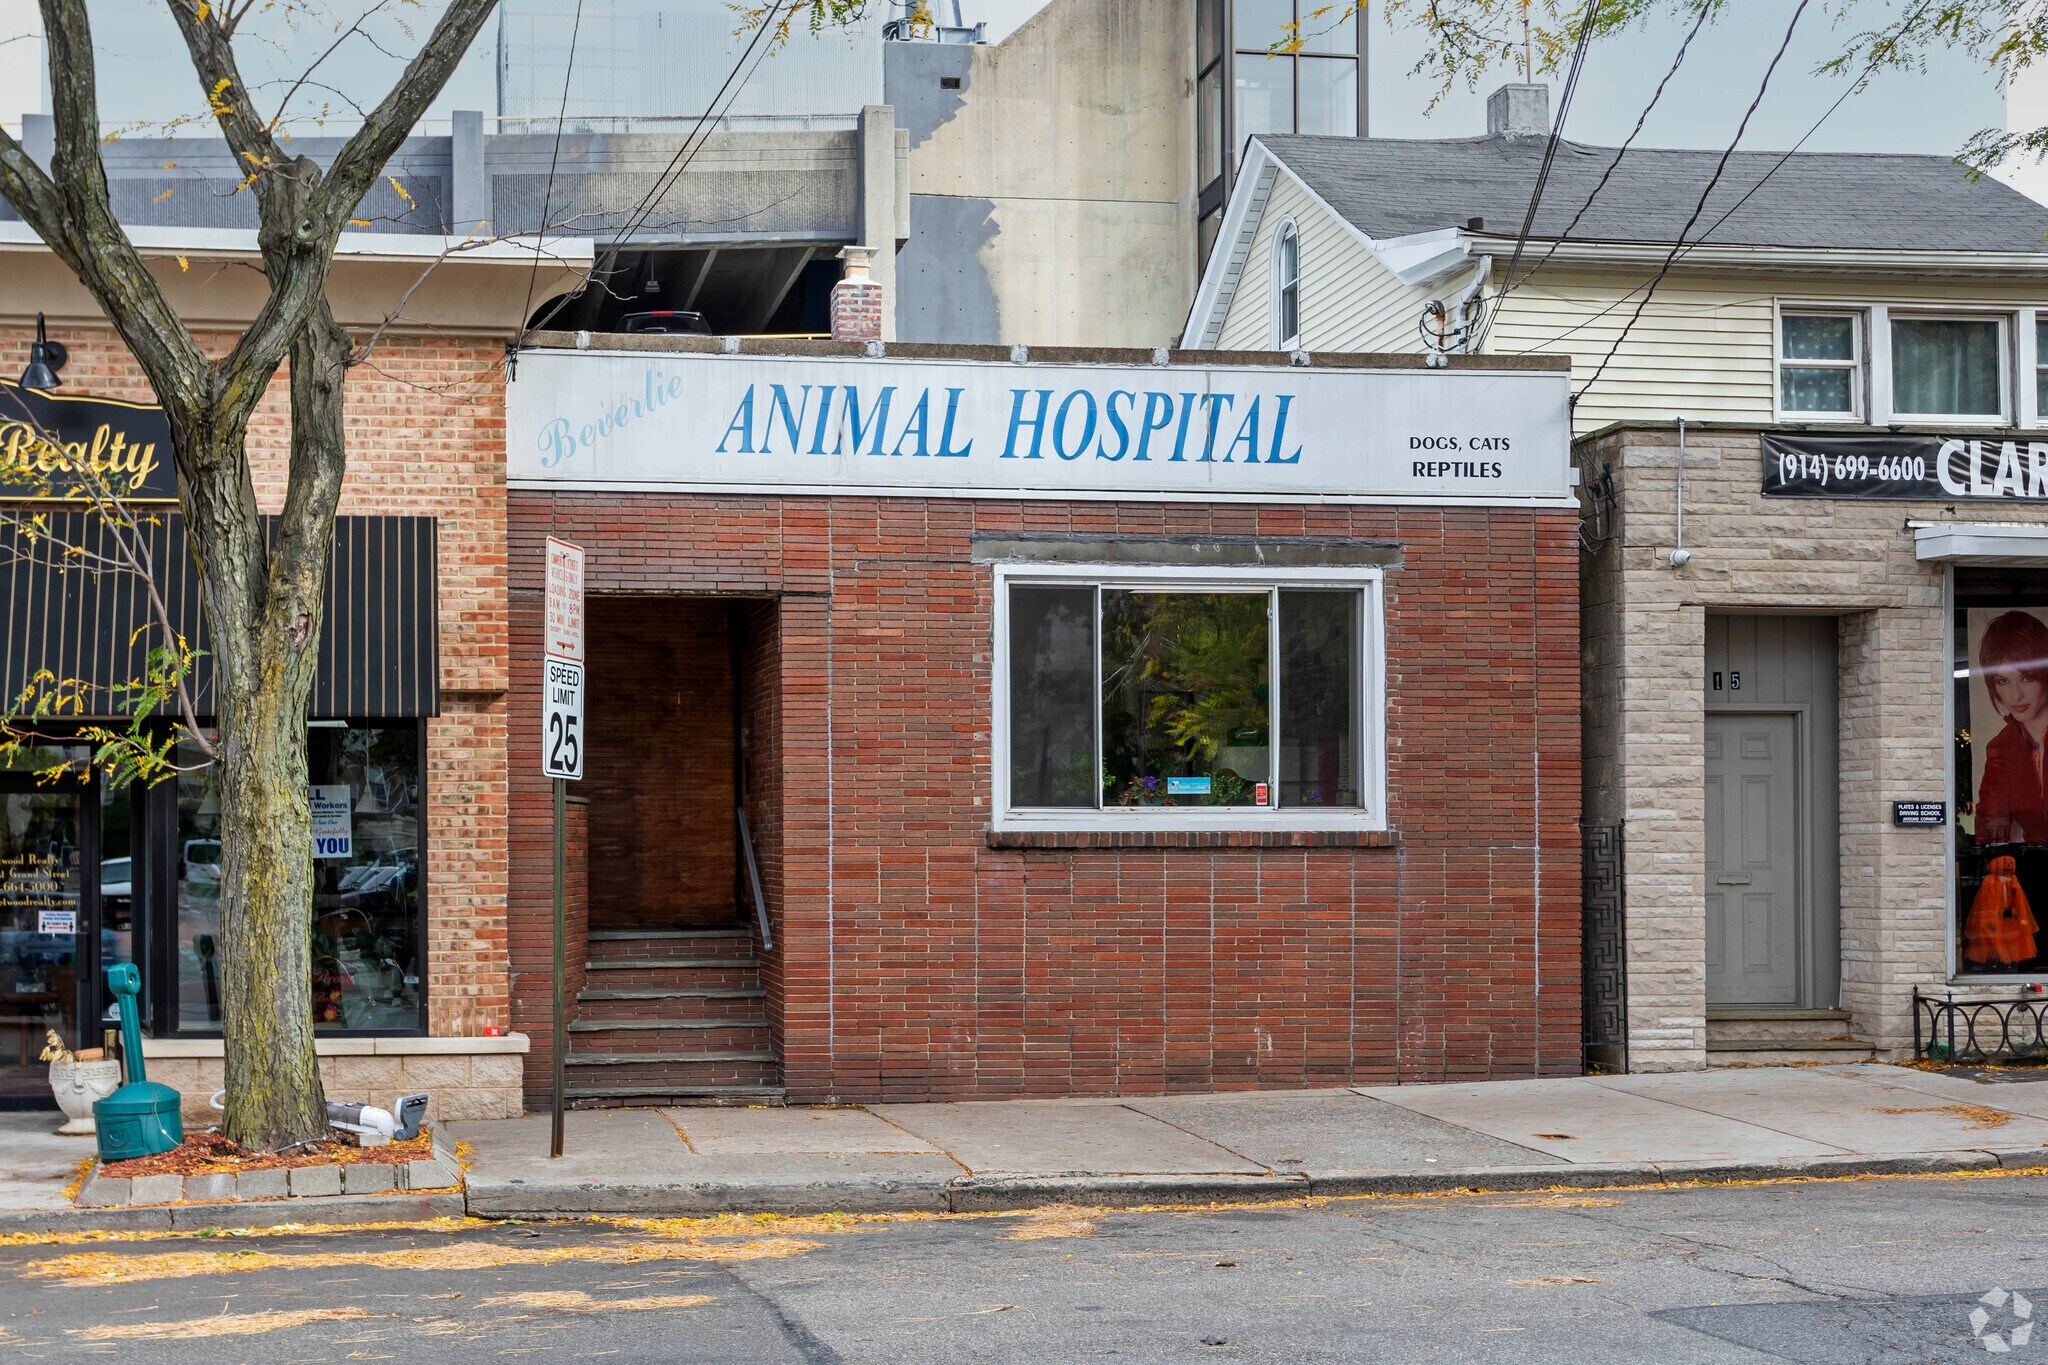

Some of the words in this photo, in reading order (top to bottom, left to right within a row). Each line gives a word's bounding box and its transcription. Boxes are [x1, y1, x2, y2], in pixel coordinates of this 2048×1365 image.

[537, 368, 685, 469] Beverlie
[715, 383, 974, 458] ANIMAL
[1000, 388, 1303, 465] HOSPITAL
[1409, 436, 1463, 454] DOGS,
[1468, 436, 1511, 452] CATS
[0, 422, 160, 490] Realty
[1411, 460, 1503, 478] REPTILES
[1779, 453, 1828, 487] (914)
[1834, 454, 1926, 481] 699-6600
[1936, 439, 2048, 497] CLAR
[550, 666, 579, 687] SPEED
[552, 686, 576, 707] LIMIT
[549, 711, 578, 773] 25
[314, 801, 348, 810] Workers
[316, 837, 349, 855] YOU
[0, 853, 24, 866] wood
[28, 853, 59, 867] Realty
[9, 867, 39, 879] Grand
[43, 867, 71, 879] Street
